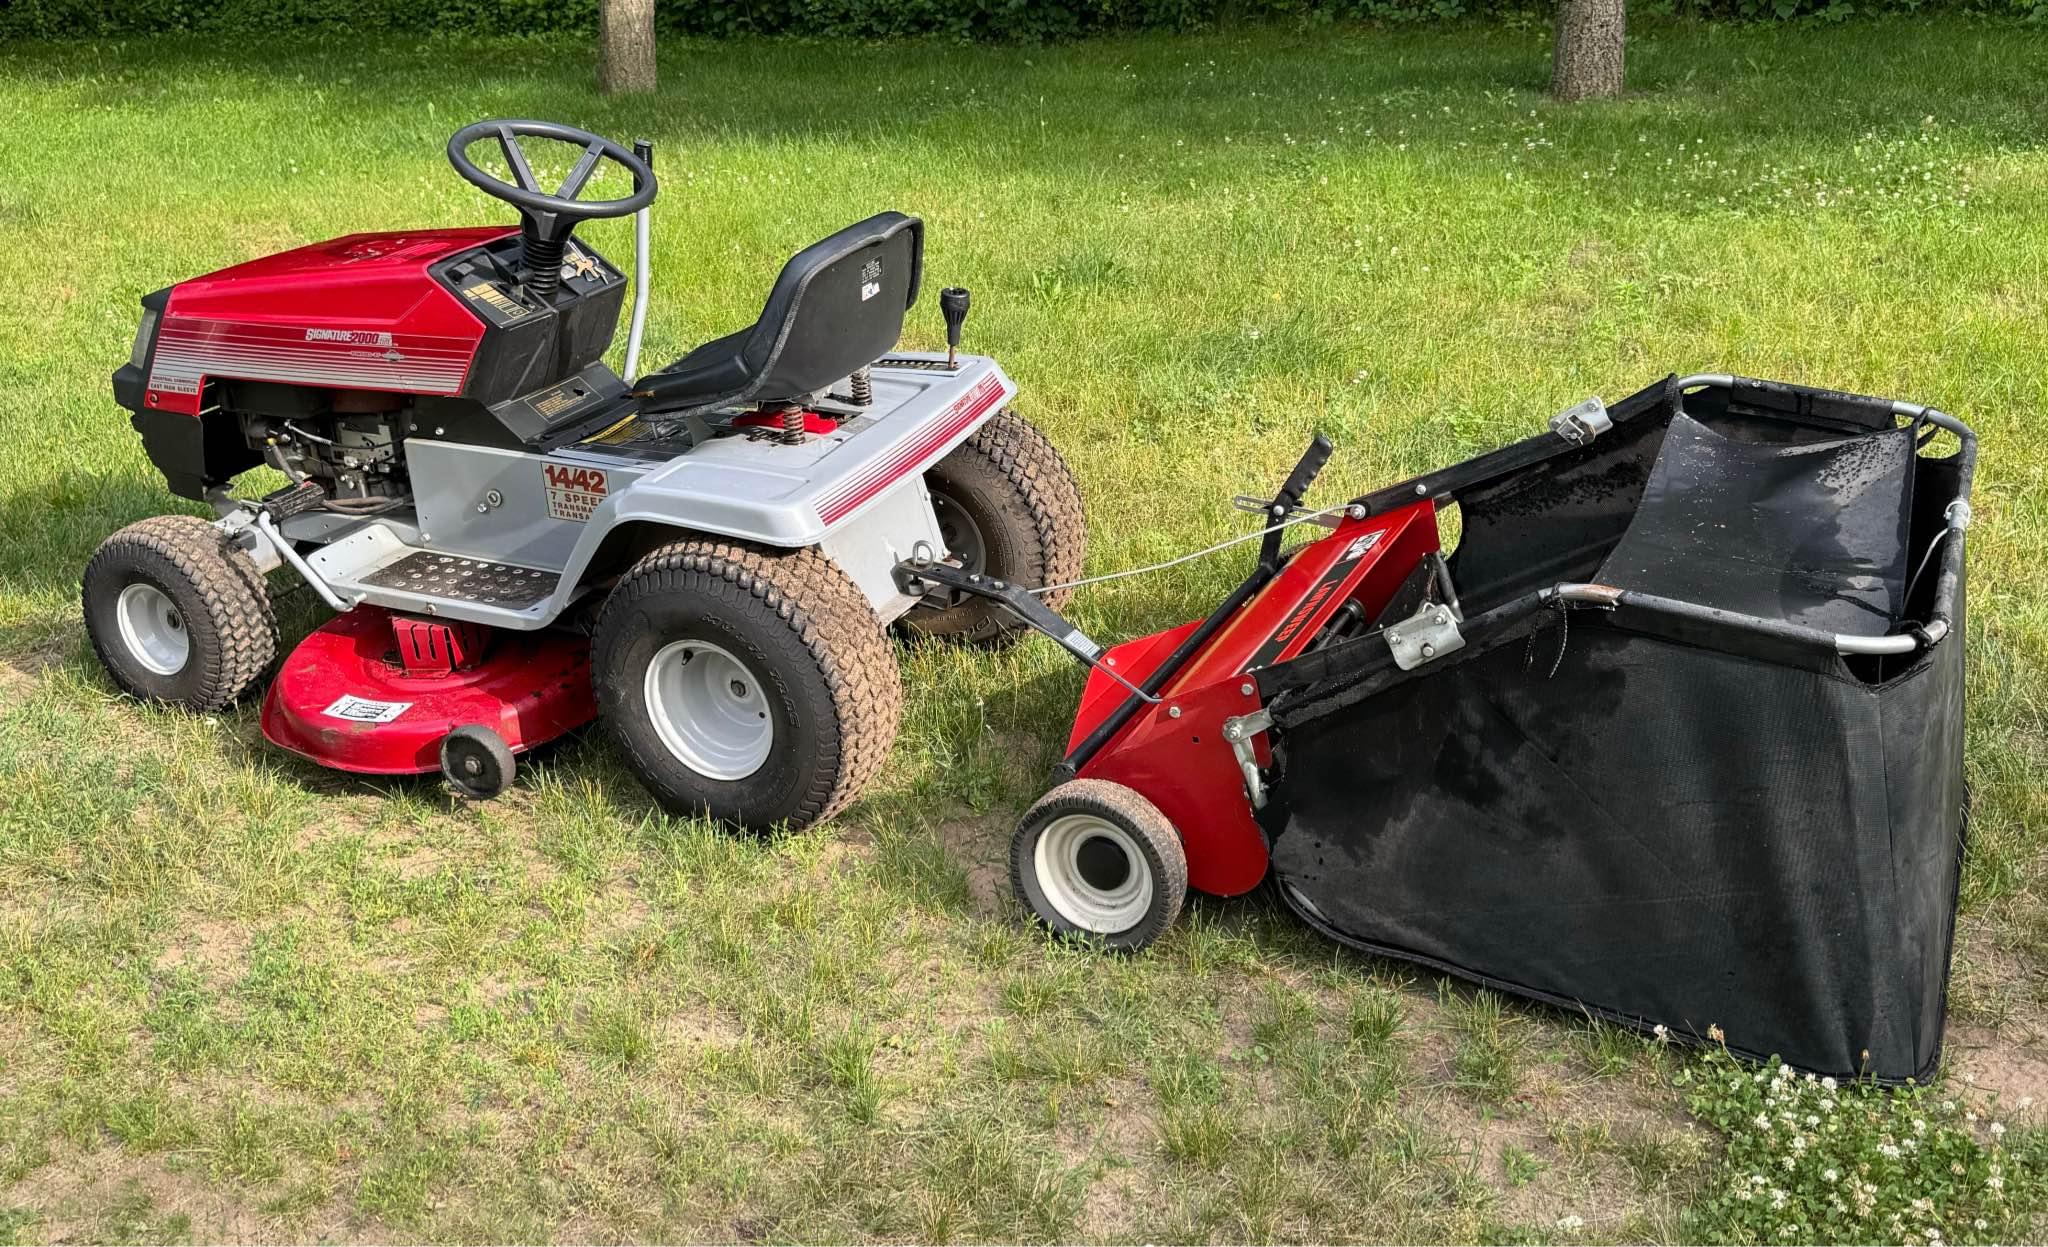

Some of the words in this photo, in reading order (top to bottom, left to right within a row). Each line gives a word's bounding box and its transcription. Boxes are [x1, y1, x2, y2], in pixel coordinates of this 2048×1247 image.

[545, 465, 607, 494] 14/42
[551, 491, 557, 500] 7
[552, 502, 596, 513] TRANSMA
